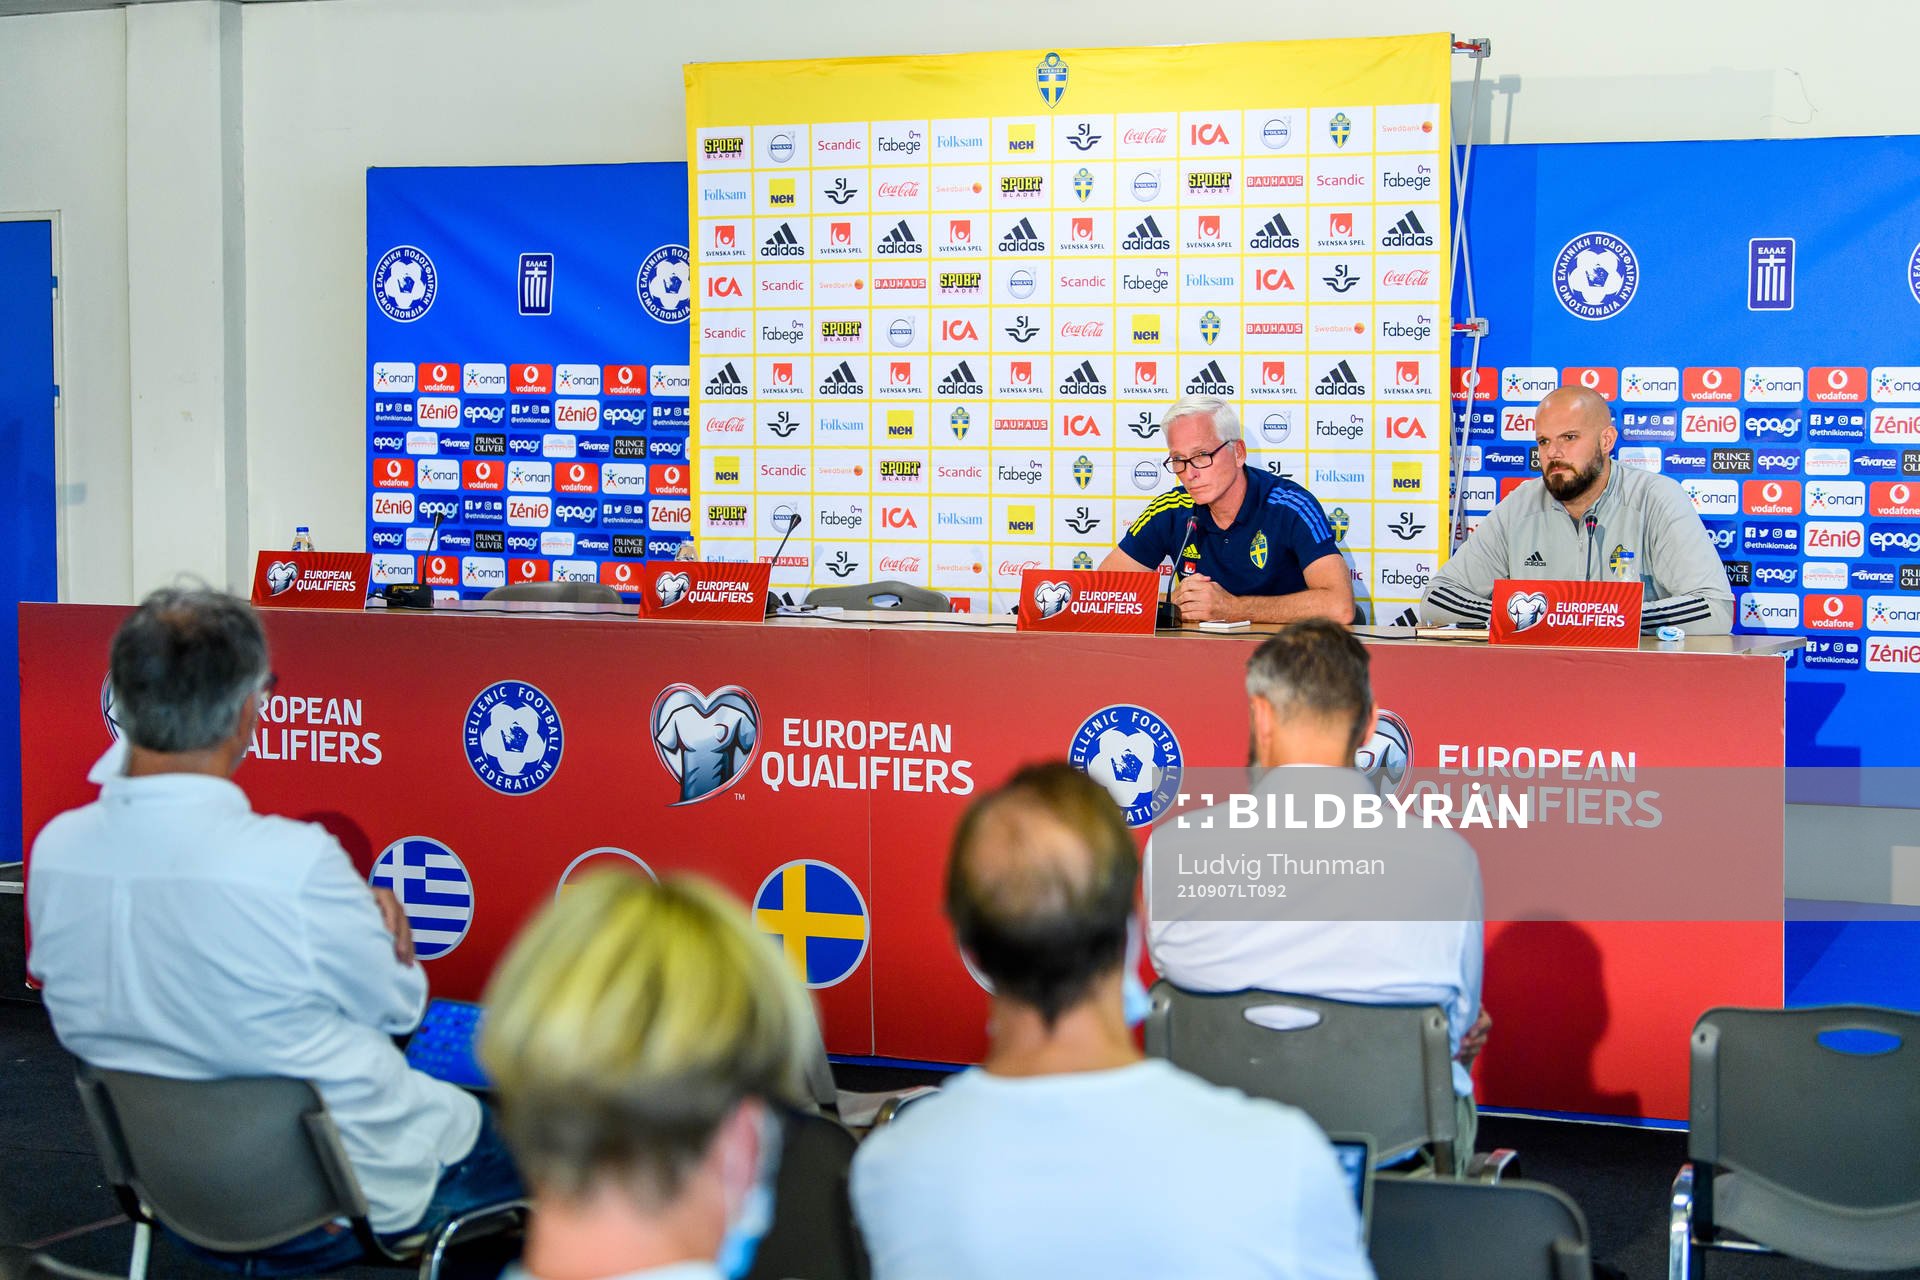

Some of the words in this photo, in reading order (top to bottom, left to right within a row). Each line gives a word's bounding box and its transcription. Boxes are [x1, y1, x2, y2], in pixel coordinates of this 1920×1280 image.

[1078, 124, 1090, 135] SJ
[1191, 124, 1229, 145] ICA
[704, 138, 744, 152] SPORT
[818, 139, 861, 150] Scandic
[879, 137, 921, 154] Fabege
[937, 135, 982, 147] Folksam
[835, 178, 847, 189] SJ
[1189, 172, 1232, 187] SPORT
[1247, 176, 1303, 186] BAUHAUS
[1317, 174, 1365, 186] Scandic
[1384, 172, 1431, 190] Fabege
[704, 189, 746, 200] Folksam
[998, 240, 1045, 251] adidas
[1122, 238, 1170, 250] adidas
[1250, 236, 1299, 248] adidas
[1382, 234, 1433, 247] adidas
[761, 246, 804, 256] adidas
[877, 242, 922, 254] adidas
[1558, 238, 1591, 281] ΕΛΛΗΝΙΚΗ
[378, 250, 401, 288] ΕΛΛΗΝΙΚΗ
[640, 249, 668, 288] ΕΛΛΗΝΙΚΗ
[1335, 265, 1348, 277] SJ
[1596, 237, 1634, 301] ΠΟΔΟΣΦΑΙΡΙΚΗ
[404, 249, 434, 304] ΠΟΔΟΣΦΑΙΡΙΚΗ
[940, 273, 981, 288] SPORT
[1061, 276, 1106, 287] Scandic
[1186, 275, 1234, 286] Folksam
[1256, 269, 1295, 290] ICA
[708, 277, 743, 297] ICA
[762, 280, 804, 291] Scandic
[874, 279, 926, 288] BAUHAUS
[1123, 275, 1168, 292] Fabege
[378, 292, 424, 319] ΟΜΟΣΠΟΝΔΙΑ
[1559, 285, 1621, 316] ΟΜΟΣΠΟΝΔΙΑ
[1017, 316, 1028, 328] SJ
[704, 328, 746, 339] Scandic
[762, 326, 804, 343] Fabege
[942, 320, 978, 341] ICA
[1247, 323, 1302, 334] BAUHAUS
[1383, 322, 1431, 340] Fabege
[705, 384, 748, 395] adidas
[819, 383, 863, 394] adidas
[938, 383, 983, 394] adidas
[1060, 383, 1107, 395] adidas
[1186, 383, 1234, 395] adidas
[1315, 383, 1365, 395] adidas
[1692, 392, 1732, 400] vodafone
[1817, 392, 1858, 400] vodafone
[778, 412, 789, 423] SJ
[1139, 412, 1152, 423] SJ
[820, 419, 864, 431] Folksam
[995, 420, 1047, 429] BAUHAUS
[1063, 415, 1101, 436] ICA
[1317, 421, 1364, 439] Fabege
[1386, 417, 1426, 438] ICA
[1810, 429, 1863, 437] @ethnikiomada
[446, 440, 470, 448] avance
[475, 437, 504, 445] PRINCE
[614, 439, 644, 448] PRINCE
[475, 445, 504, 453] OLIVER
[614, 447, 644, 455] OLIVER
[1713, 453, 1750, 461] PRINCE
[1863, 457, 1896, 466] avance
[761, 464, 806, 476] Scandic
[880, 461, 921, 476] SPORT
[1713, 461, 1750, 469] OLIVER
[938, 467, 982, 478] Scandic
[999, 466, 1042, 484] Fabege
[1315, 470, 1364, 482] Folksam
[655, 486, 687, 494] vodafone
[709, 506, 746, 520] SPORT
[1077, 507, 1089, 519] SJ
[1751, 505, 1792, 513] vodafone
[821, 511, 862, 528] Fabege
[882, 508, 917, 528] ICA
[937, 513, 982, 525] Folksam
[1401, 512, 1414, 524] SJ
[475, 534, 503, 542] PRINCE
[475, 540, 503, 549] OLIVER
[836, 551, 848, 562] SJ
[304, 570, 352, 580] EUROPEAN
[1382, 571, 1429, 589] Fabege
[297, 580, 356, 592] QUALIFIERS
[696, 581, 749, 591] EUROPEAN
[688, 591, 754, 603] QUALIFIERS
[1079, 591, 1137, 601] EUROPEAN
[1071, 602, 1143, 614] QUALIFIERS
[1556, 602, 1619, 615] EUROPEAN
[1546, 613, 1625, 627] QUALIFIERS
[1812, 619, 1853, 628] vodafone
[1805, 656, 1858, 664] @ethnikiomada
[256, 696, 362, 726] ROPEAN
[469, 687, 507, 745] HELLENIC
[518, 688, 558, 752] FOOTBALL
[783, 718, 951, 753] EUROPEAN
[243, 729, 382, 767] ALIFIERS
[1074, 711, 1119, 775] ELLENIC
[1131, 711, 1177, 781] FOOTBALL
[1438, 745, 1636, 782] EUROPEAN
[474, 757, 552, 791] FEDERATION
[762, 751, 974, 795] QUALIFIERS
[1124, 792, 1169, 823] ATION
